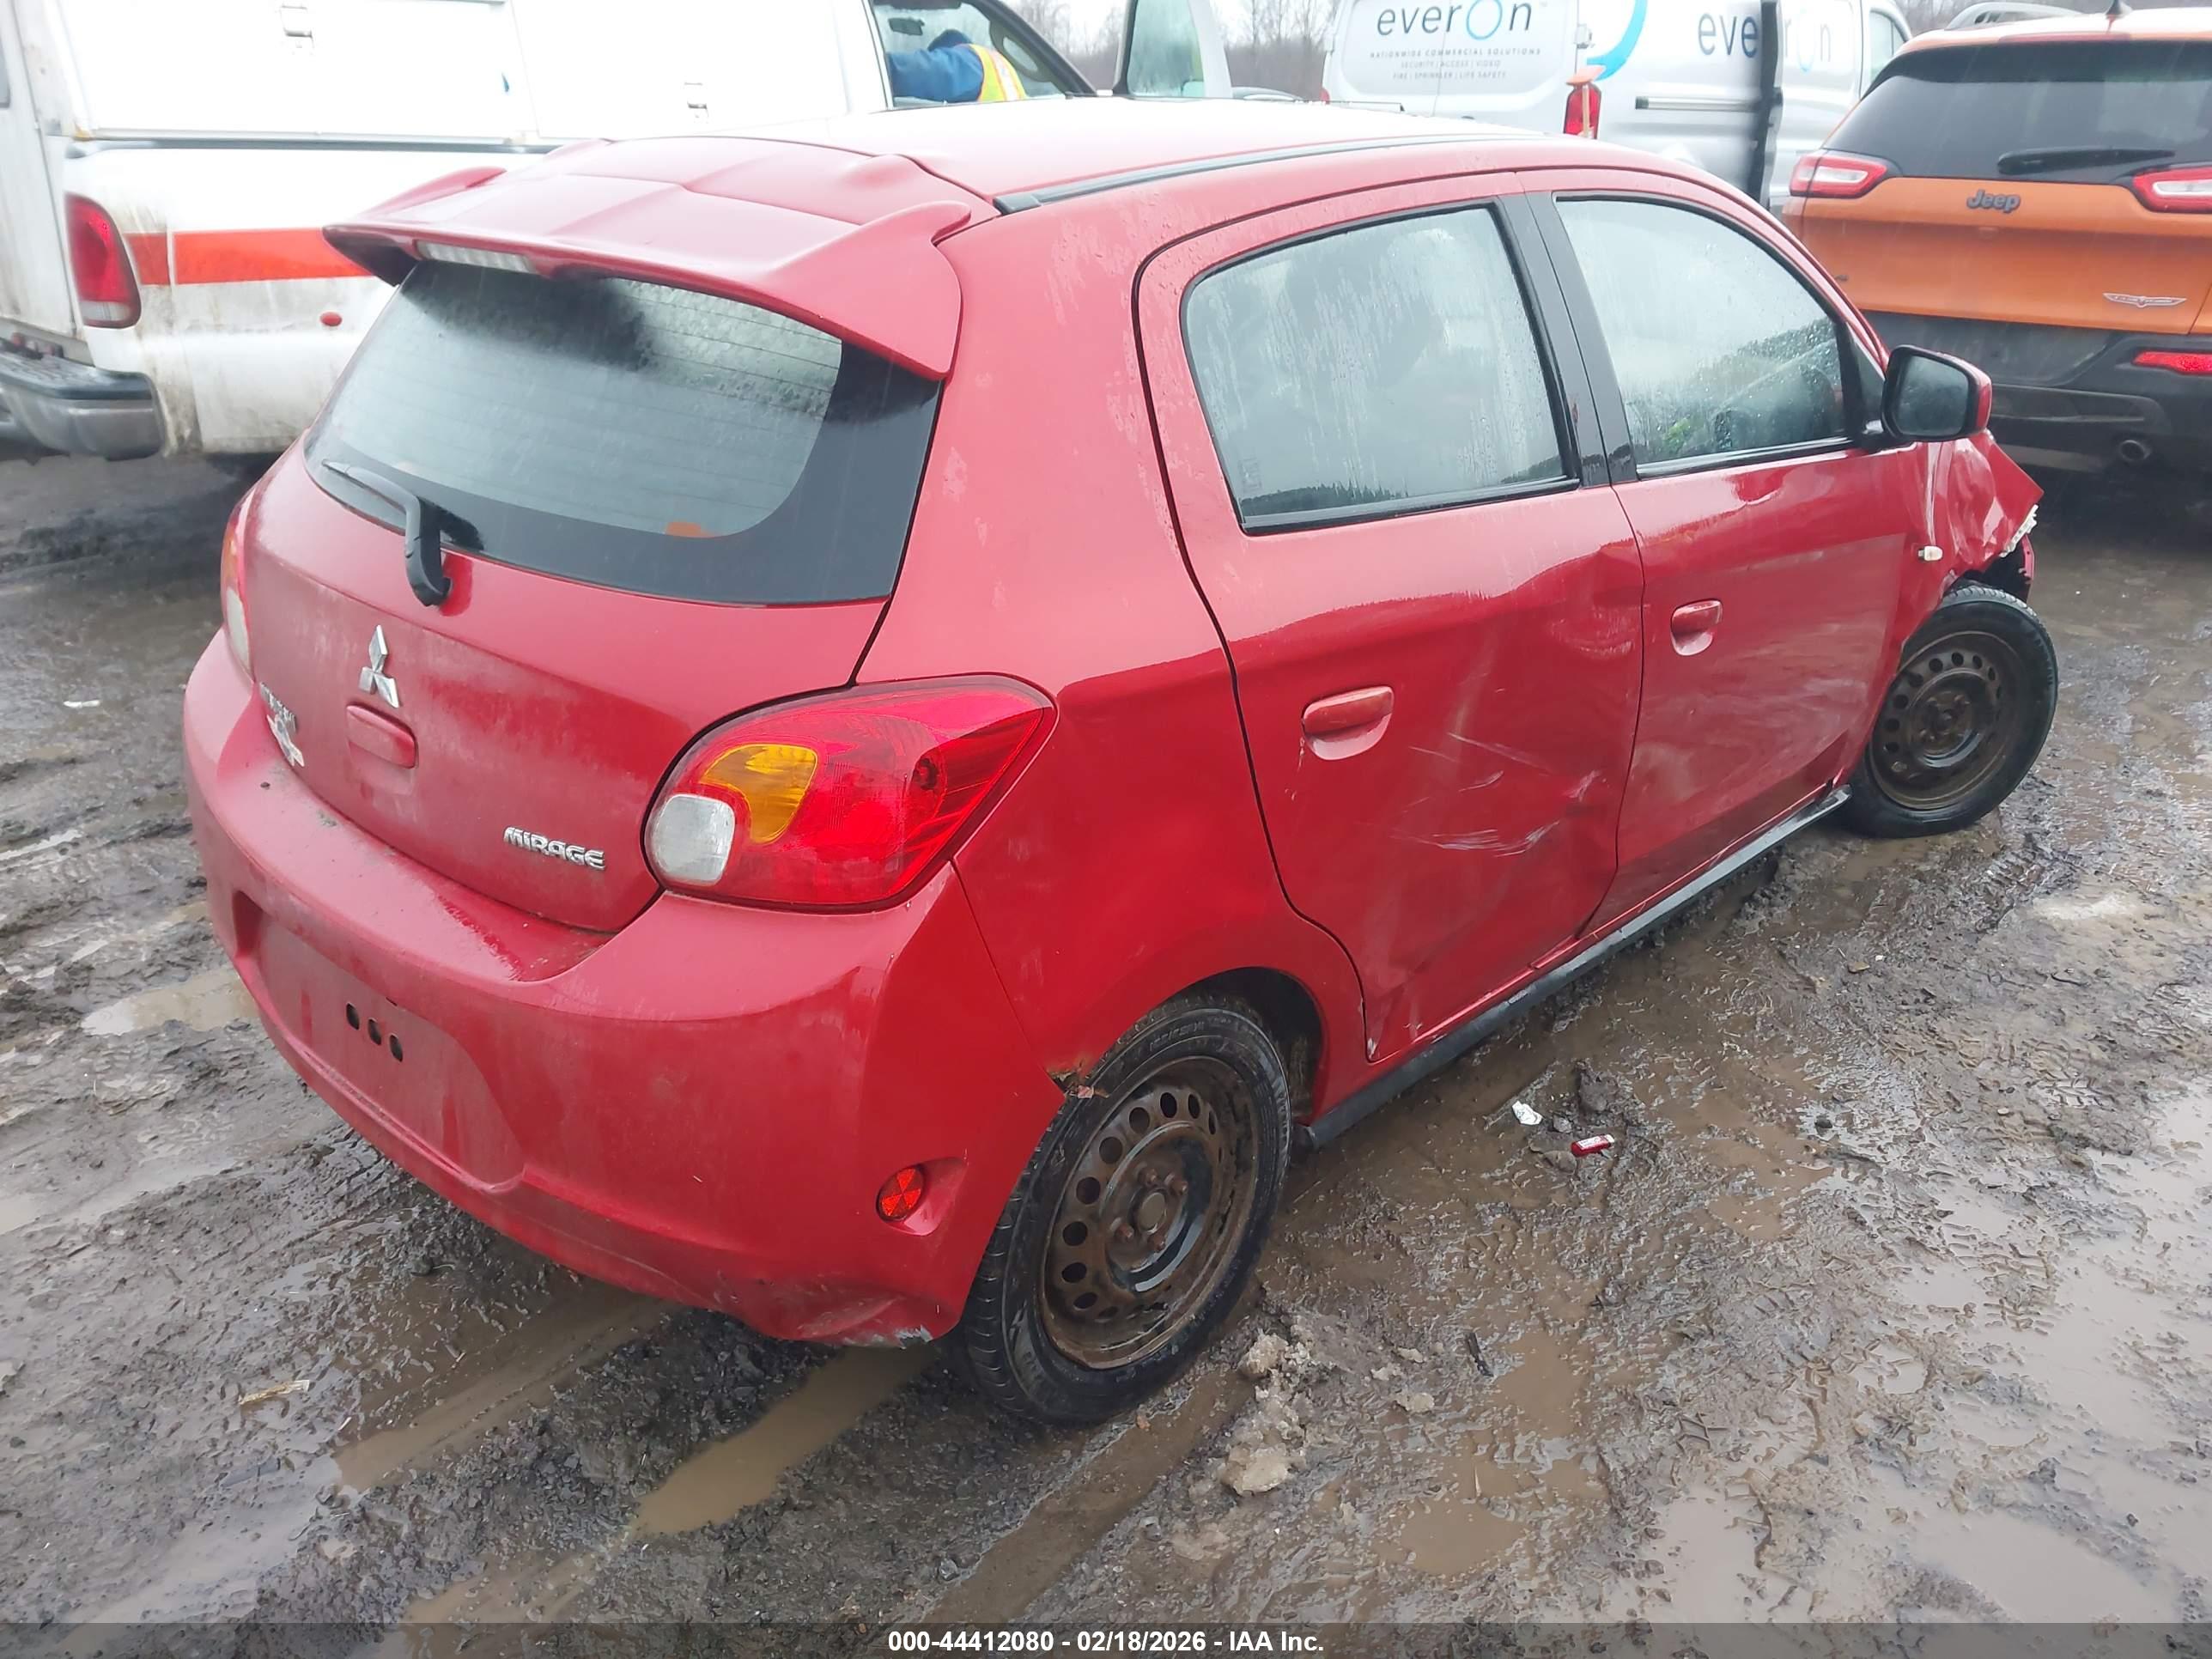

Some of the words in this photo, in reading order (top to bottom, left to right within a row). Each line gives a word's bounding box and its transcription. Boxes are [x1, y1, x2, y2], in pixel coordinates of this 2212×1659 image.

[1376, 0, 1532, 40] everOn
[1425, 47, 1484, 57] COMMERCIAL
[1487, 47, 1541, 56] SOLUTIONS
[1966, 188, 2021, 214] Jeep
[503, 826, 605, 870] MIRAGE
